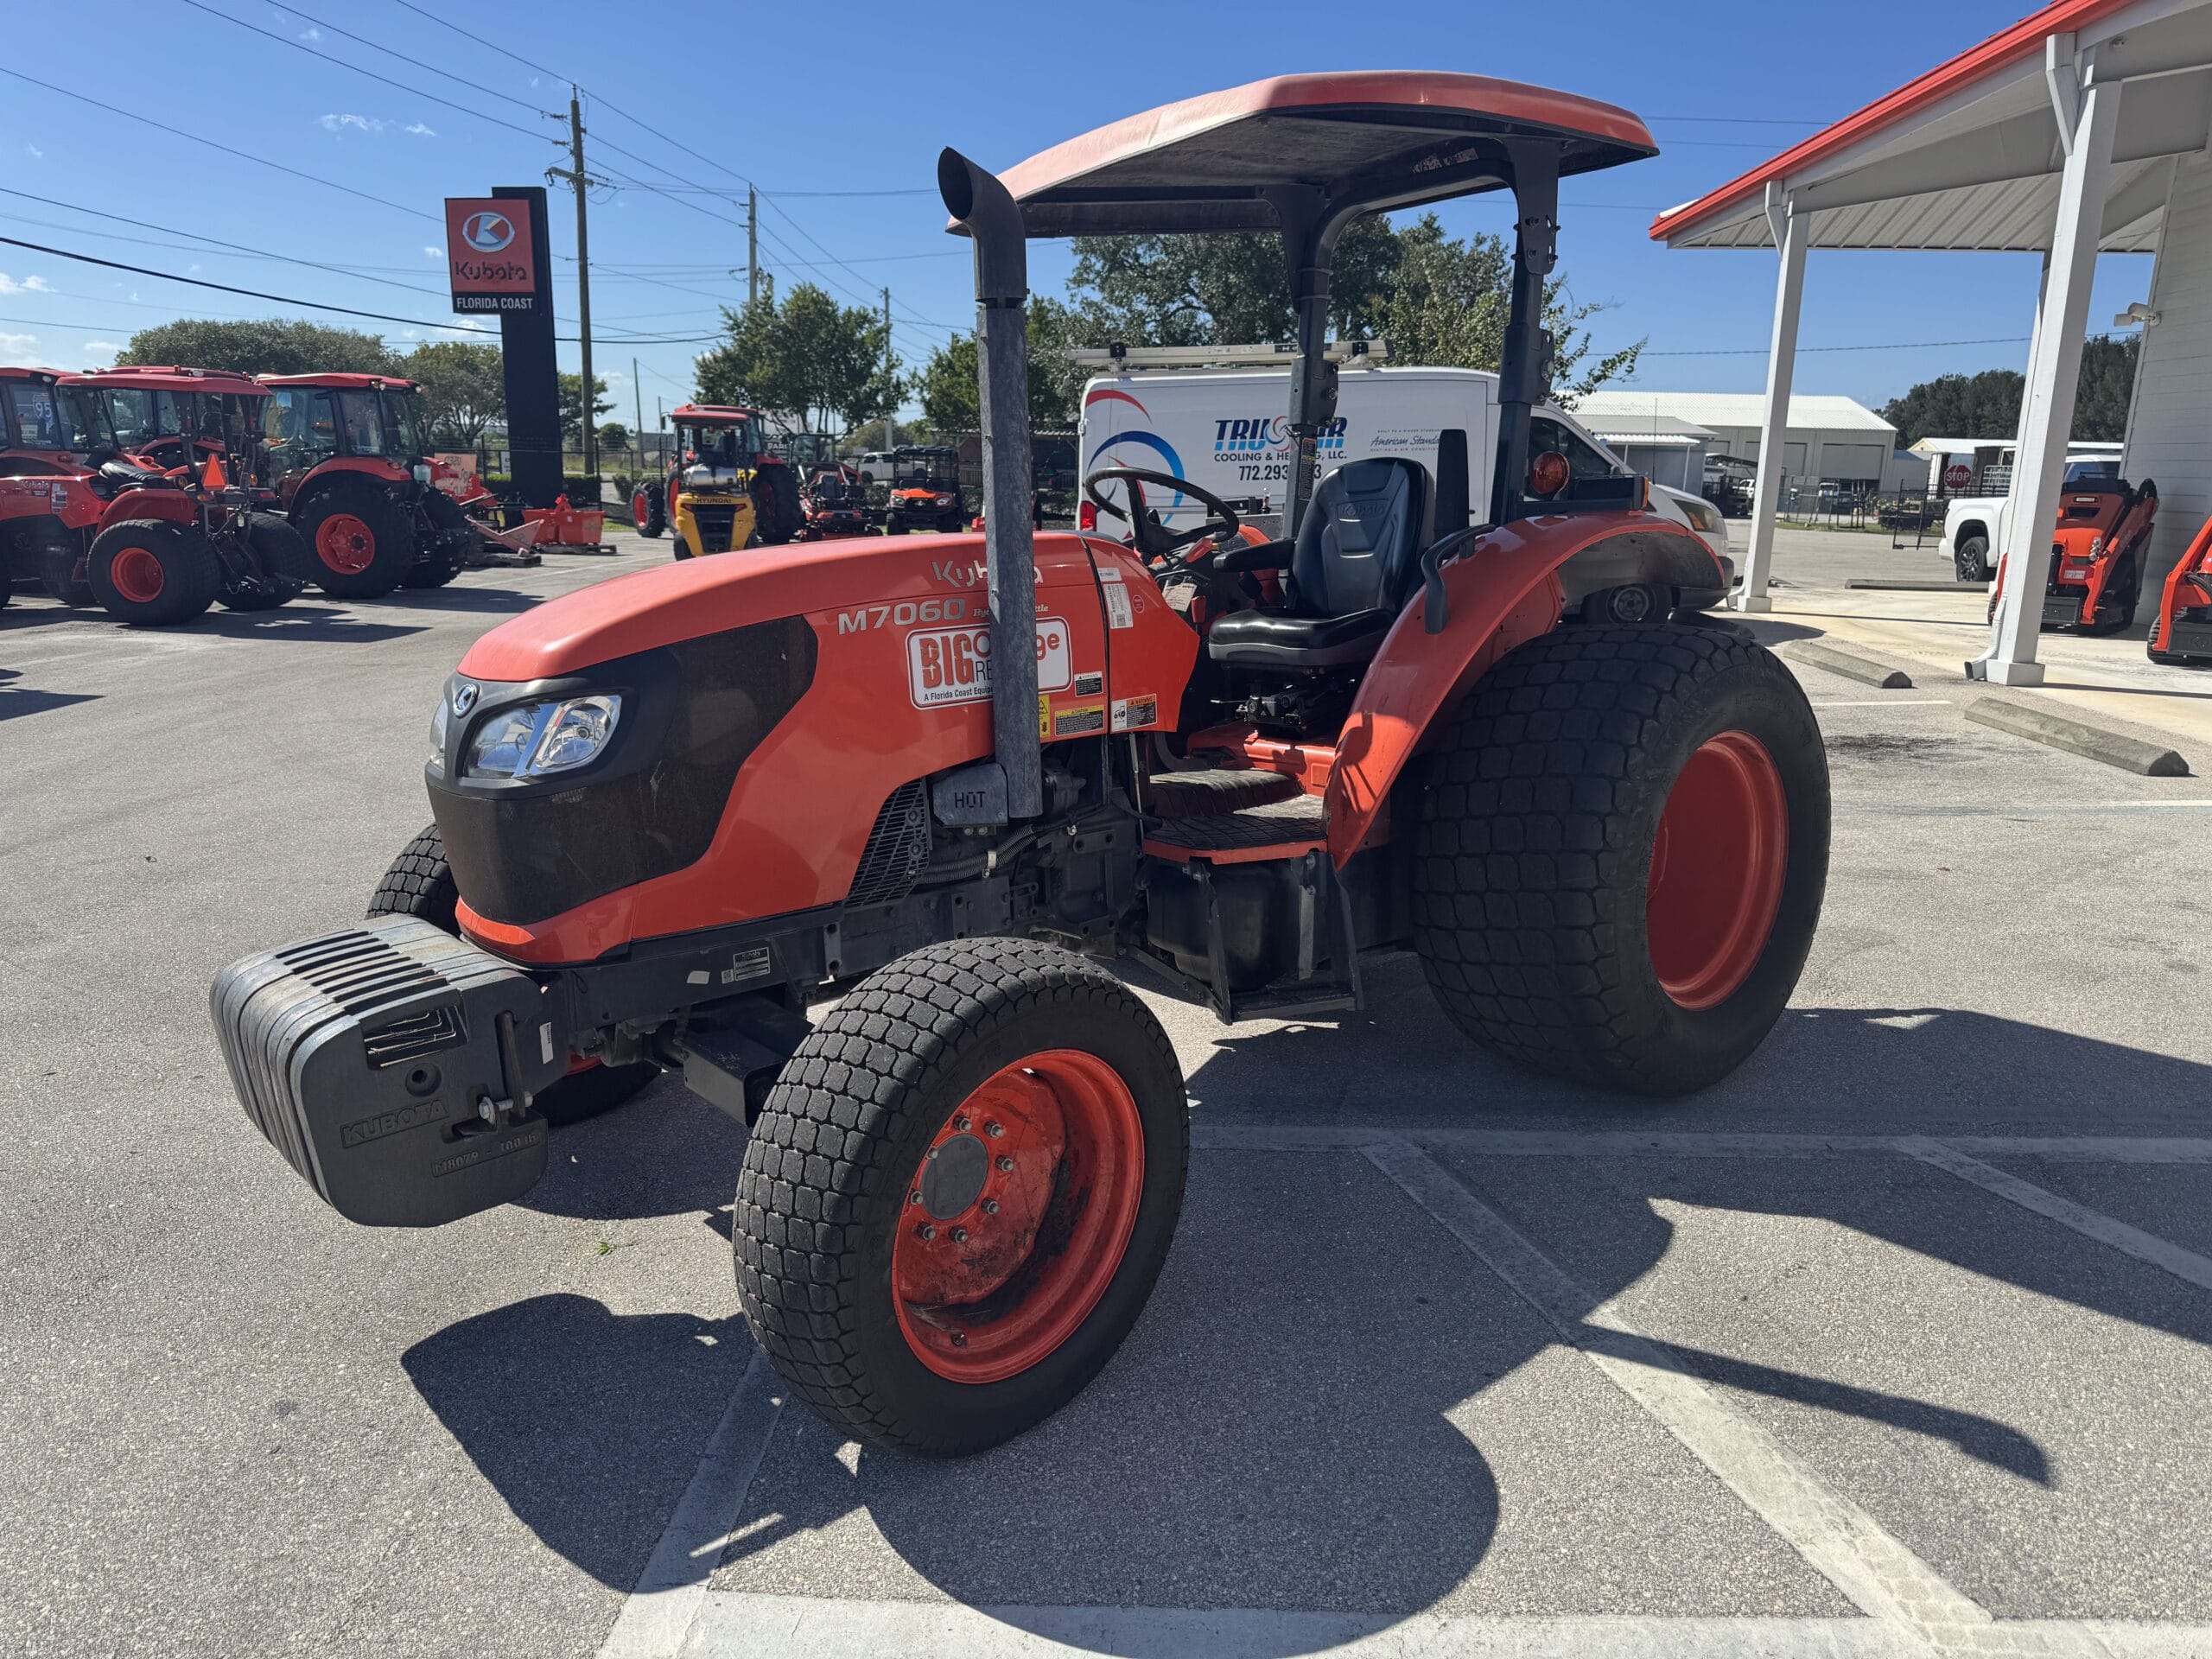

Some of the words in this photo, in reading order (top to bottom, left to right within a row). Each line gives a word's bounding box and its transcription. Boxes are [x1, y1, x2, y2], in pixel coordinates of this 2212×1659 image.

[455, 262, 527, 281] Kubota
[456, 297, 499, 308] FLORIDA
[501, 298, 533, 309] COAST
[1370, 435, 1408, 446] American
[1214, 453, 1262, 462] COOLING
[1328, 450, 1347, 459] LLC.
[1946, 472, 1970, 482] STOP
[932, 560, 1044, 588] Kuba
[837, 598, 965, 635] M7060
[918, 633, 975, 689] BIG
[973, 630, 1060, 661] Oge
[931, 690, 953, 701] Florida
[955, 689, 973, 698] Coast
[954, 791, 986, 809] HOT
[342, 1099, 448, 1145] KUBOTA
[500, 1138, 521, 1152] 100
